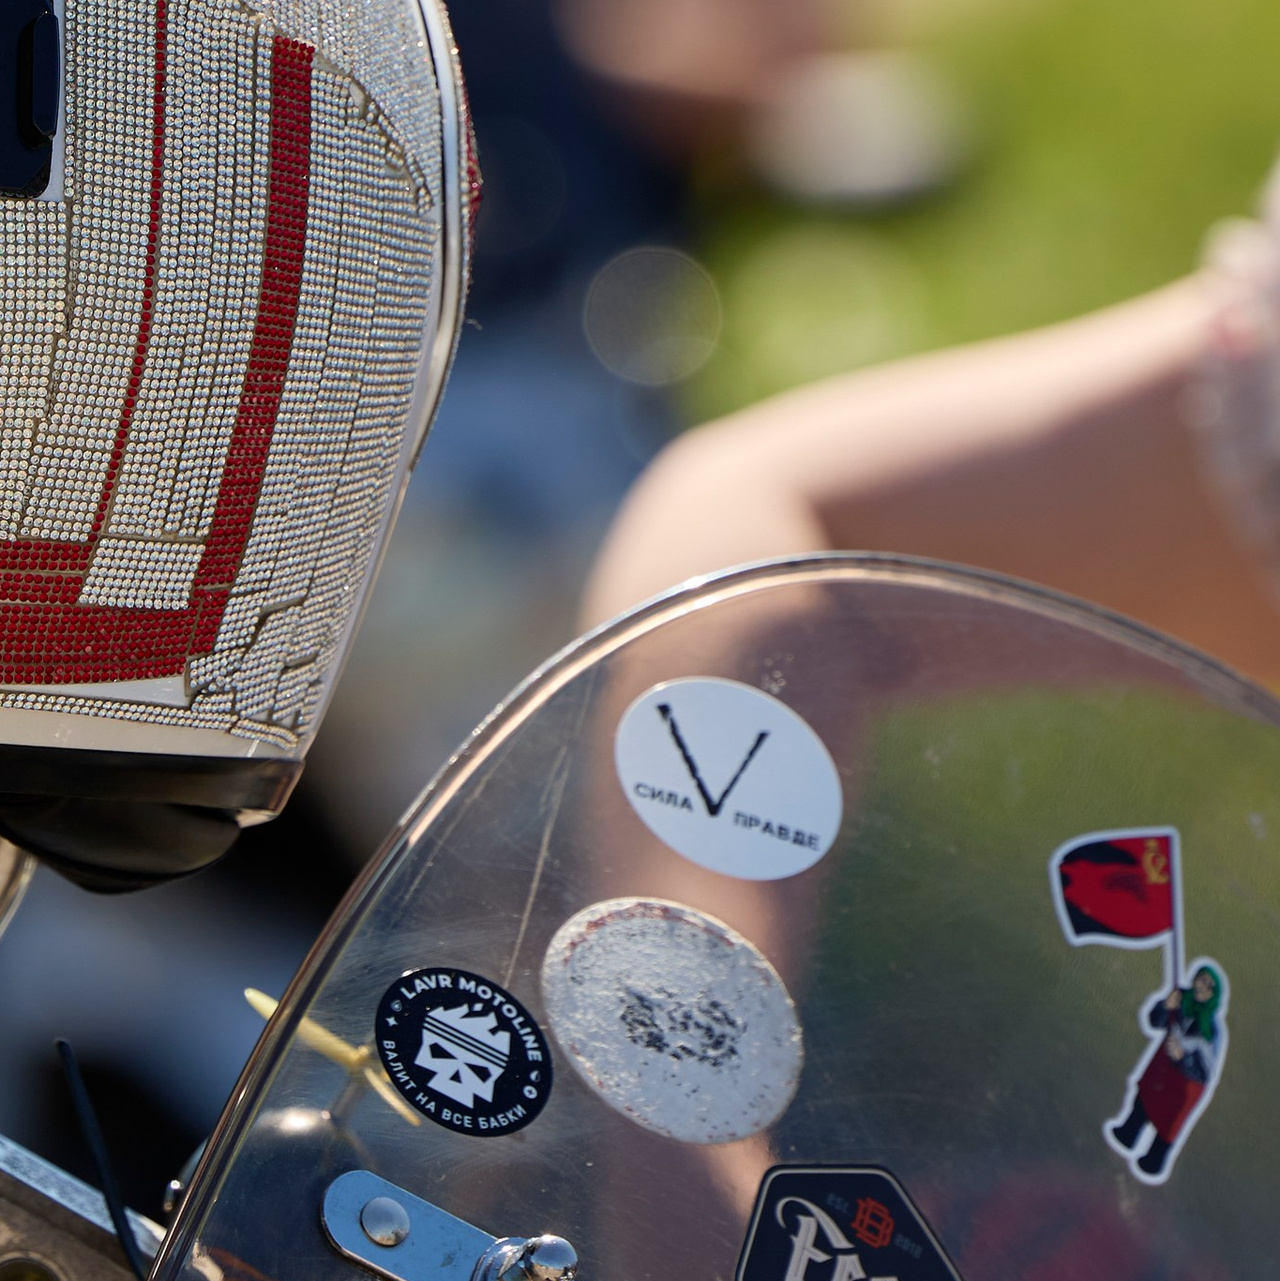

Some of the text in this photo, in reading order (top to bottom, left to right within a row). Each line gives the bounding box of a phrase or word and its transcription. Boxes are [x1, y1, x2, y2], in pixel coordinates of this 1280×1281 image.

[634, 703, 821, 851] СИЛА V ПРАВДЕ
[400, 974, 543, 1063] LAVR MOTOLINE
[382, 1040, 528, 1130] ВАЛИТ НА ВСЕ БАБКИ
